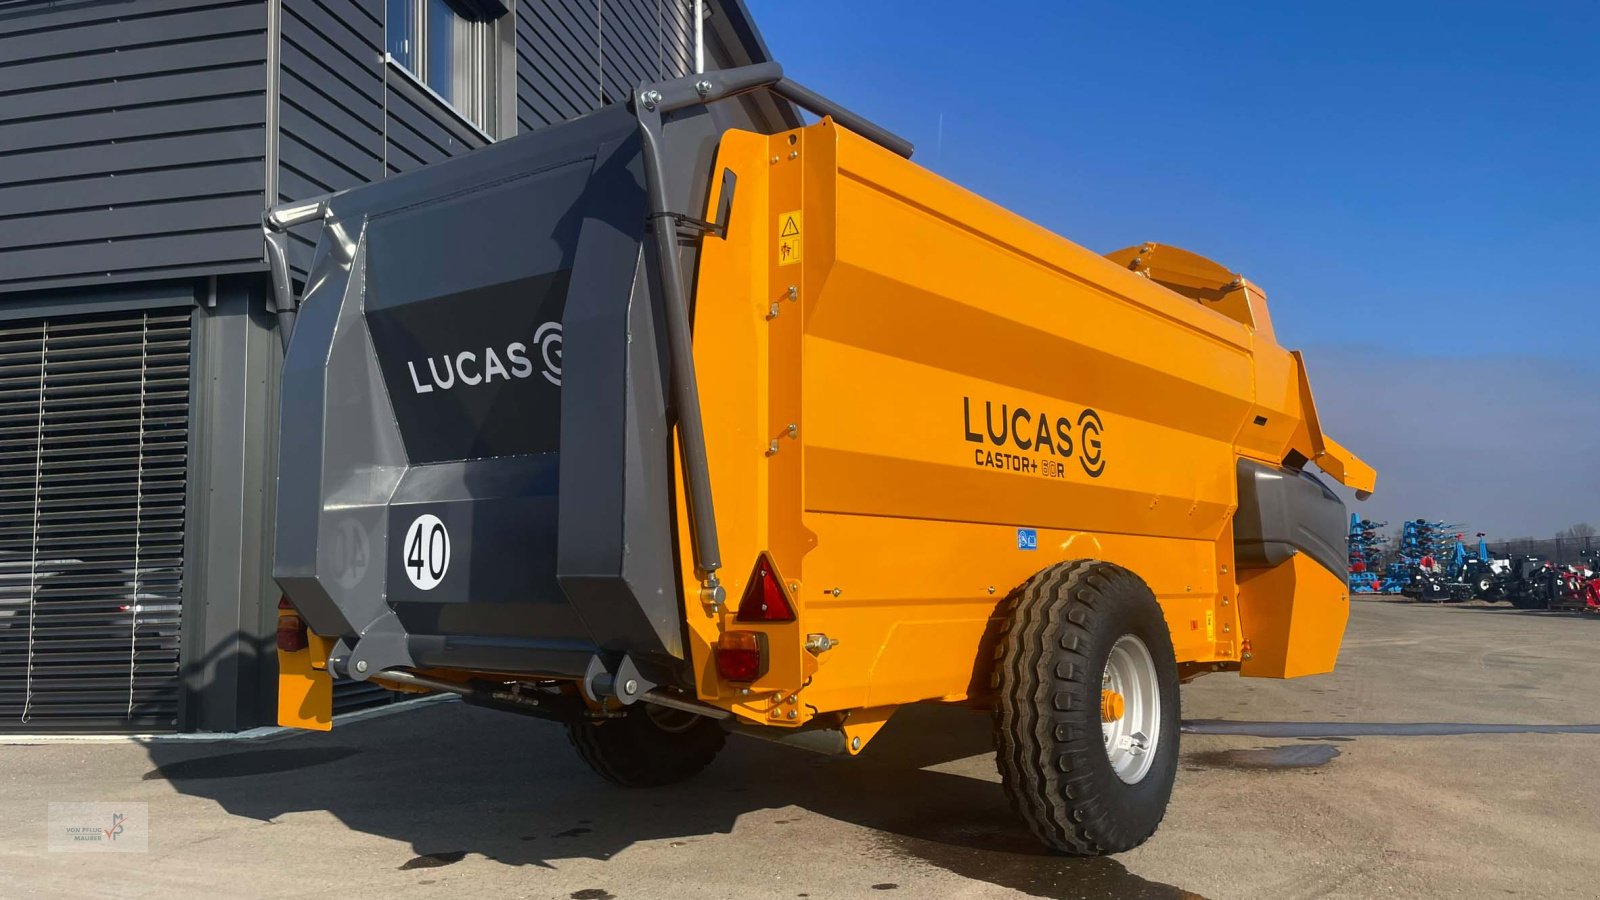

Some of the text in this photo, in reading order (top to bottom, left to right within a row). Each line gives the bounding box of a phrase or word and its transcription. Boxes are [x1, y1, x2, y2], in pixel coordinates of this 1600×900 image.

[407, 342, 533, 394] LUCAS
[963, 396, 1074, 458] LUCAS
[975, 448, 1038, 473] CASTOR+
[407, 523, 446, 580] 40
